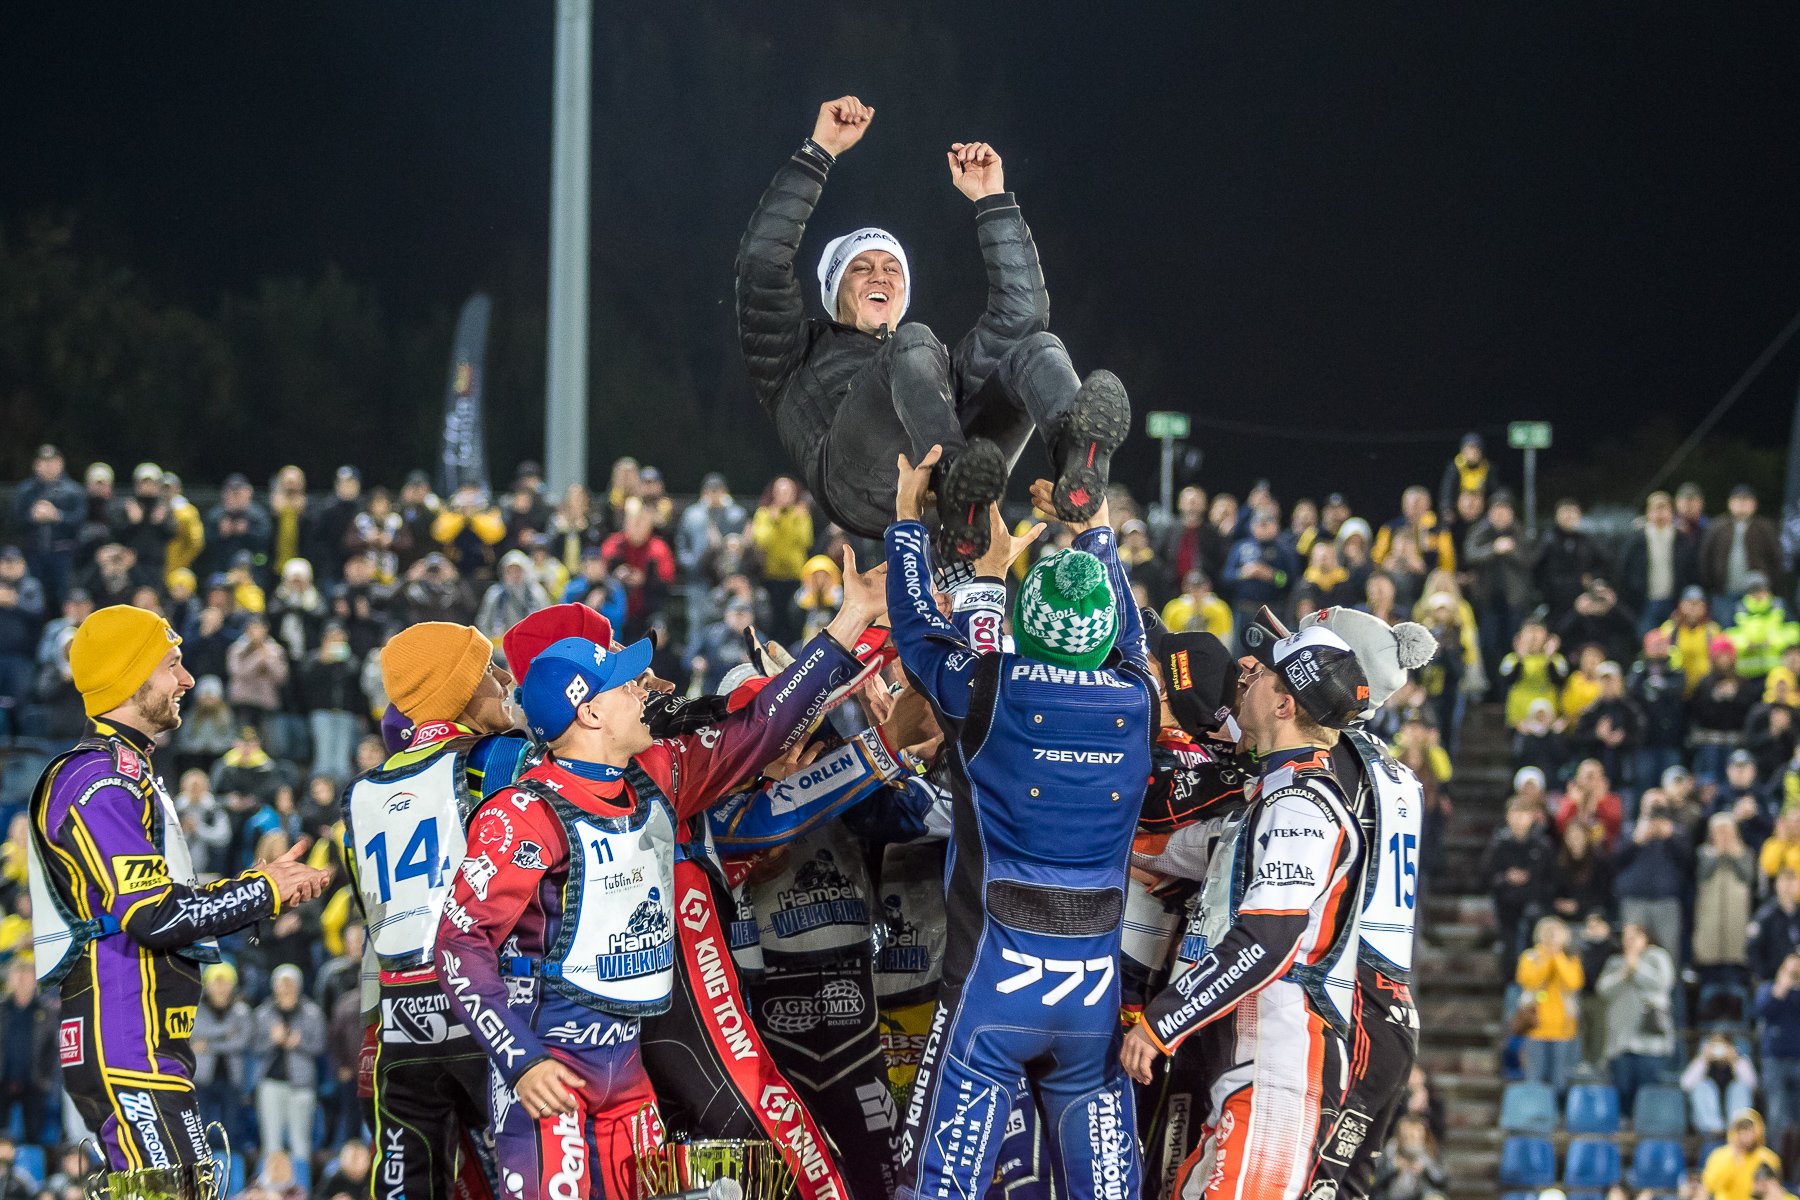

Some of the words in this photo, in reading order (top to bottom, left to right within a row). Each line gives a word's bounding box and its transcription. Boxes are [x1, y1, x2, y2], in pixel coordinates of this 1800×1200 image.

[1047, 607, 1077, 622] BOLL
[776, 648, 825, 704] PRODUCTS
[1289, 663, 1308, 686] KJH
[806, 687, 830, 716] AUTO
[780, 717, 809, 750] FRELIK
[799, 753, 854, 790] ORLEN
[1032, 748, 1124, 764] 7SEVEN7
[389, 799, 411, 814] PGE
[365, 817, 451, 902] 14
[590, 837, 614, 865] 11
[1390, 832, 1416, 909] 15
[777, 884, 856, 911] Hampel
[770, 902, 832, 938] WIELKI
[609, 922, 673, 955] Hampel
[596, 947, 656, 981] WIELKI
[995, 947, 1115, 1006] 777
[695, 937, 729, 998] KING
[713, 995, 758, 1061] TONY
[772, 999, 861, 1015] AGROMIX
[1157, 943, 1267, 1039] Mastermedia
[906, 1068, 930, 1127] KING
[922, 1001, 949, 1066] TONY
[785, 1125, 828, 1183] KING
[938, 1079, 973, 1198] BARTKOWIAK
[961, 1119, 981, 1167] TEAM
